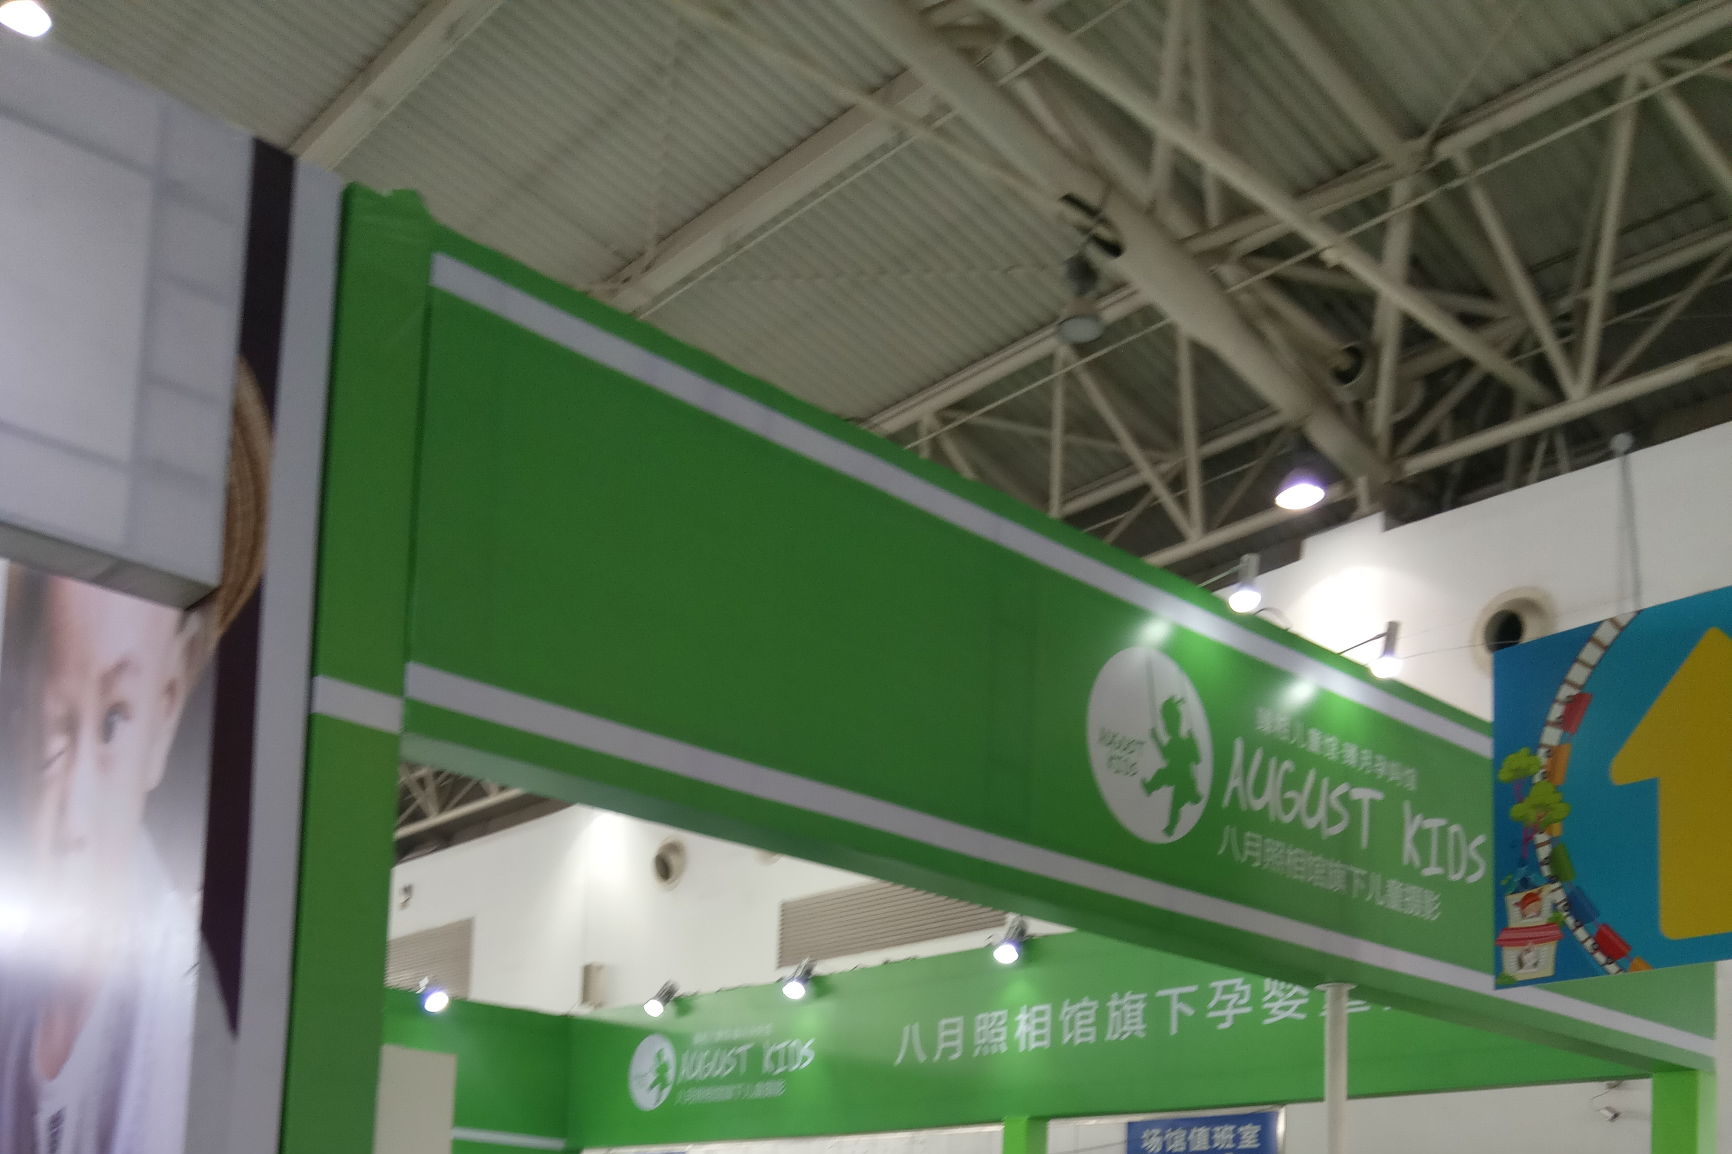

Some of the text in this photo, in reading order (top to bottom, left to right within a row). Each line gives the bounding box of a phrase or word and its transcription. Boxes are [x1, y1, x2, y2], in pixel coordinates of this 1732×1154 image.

[1222, 736, 1384, 849] AUGUST
[1402, 800, 1487, 883] KIDS
[895, 977, 1366, 1067] 八月照相馆旗下孕婴
[1141, 1123, 1262, 1154] 场馆值班室
